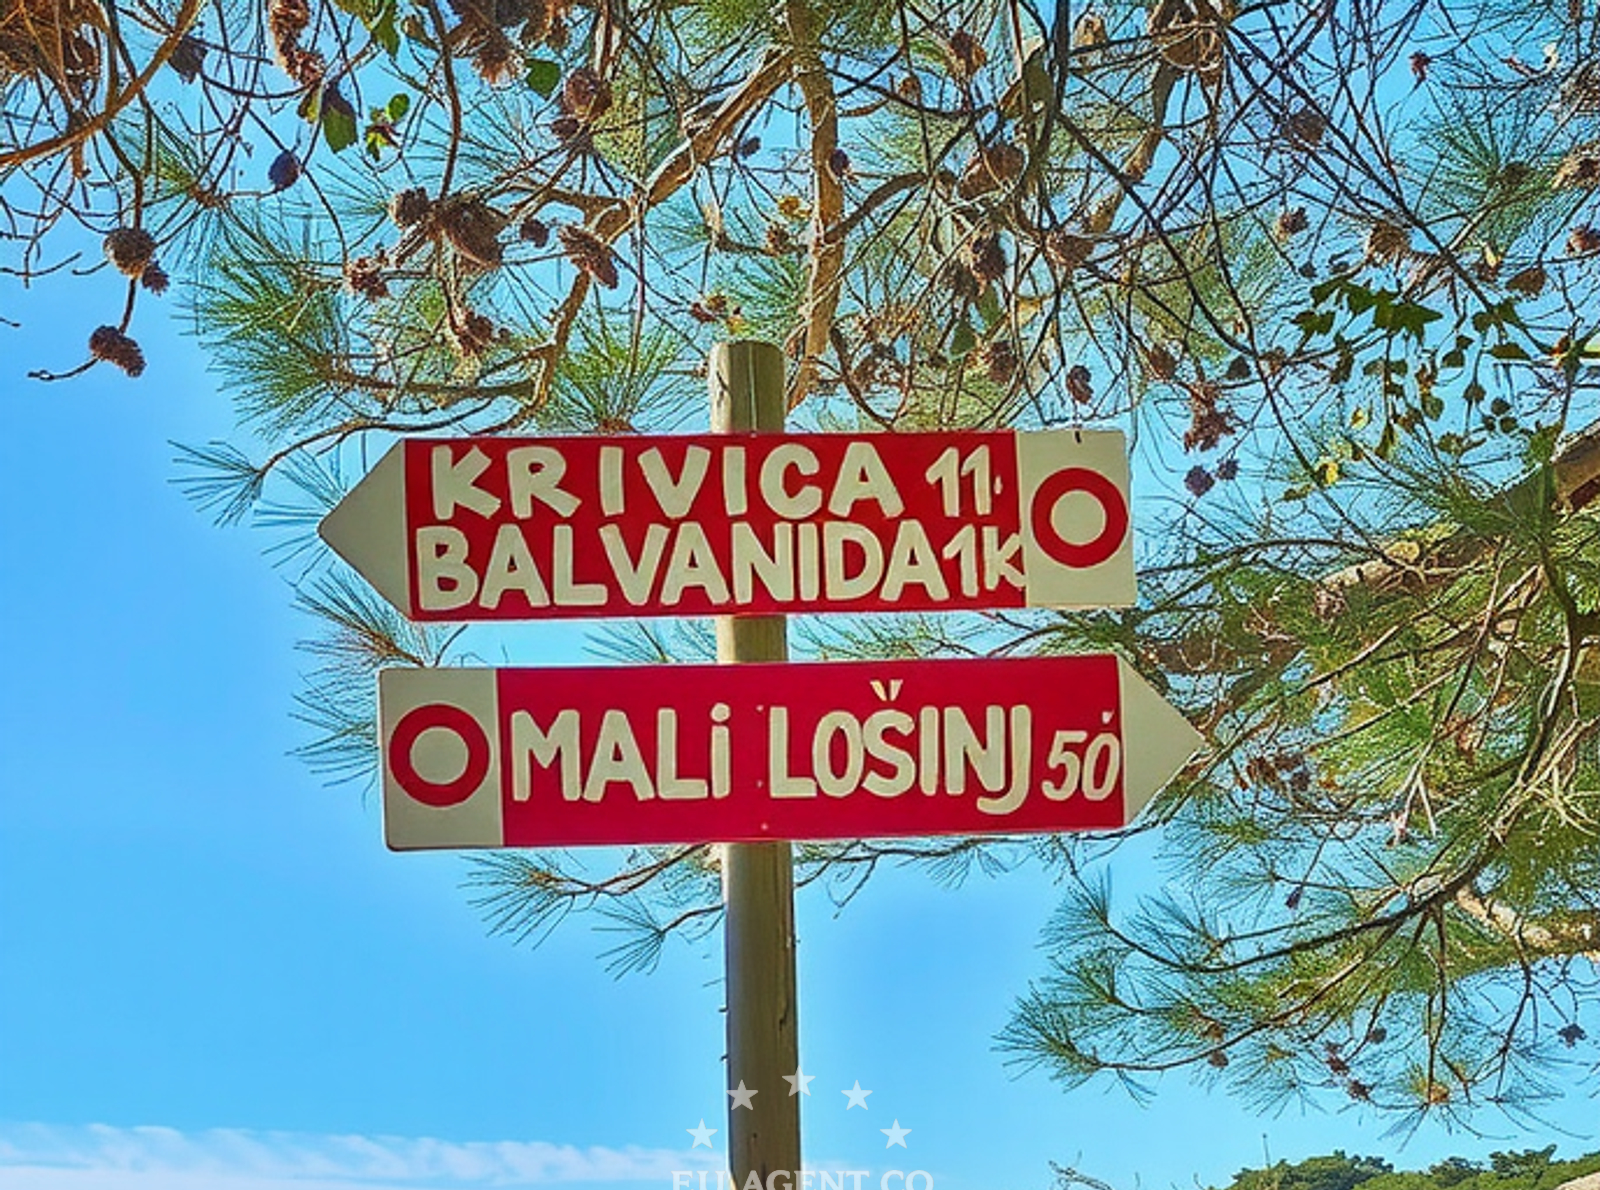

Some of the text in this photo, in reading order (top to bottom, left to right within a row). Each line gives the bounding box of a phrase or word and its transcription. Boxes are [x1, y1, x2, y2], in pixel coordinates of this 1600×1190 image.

[431, 442, 905, 520] KRIVICA
[416, 519, 950, 610] BALVANIDA
[769, 679, 1032, 815] LOŠINJ
